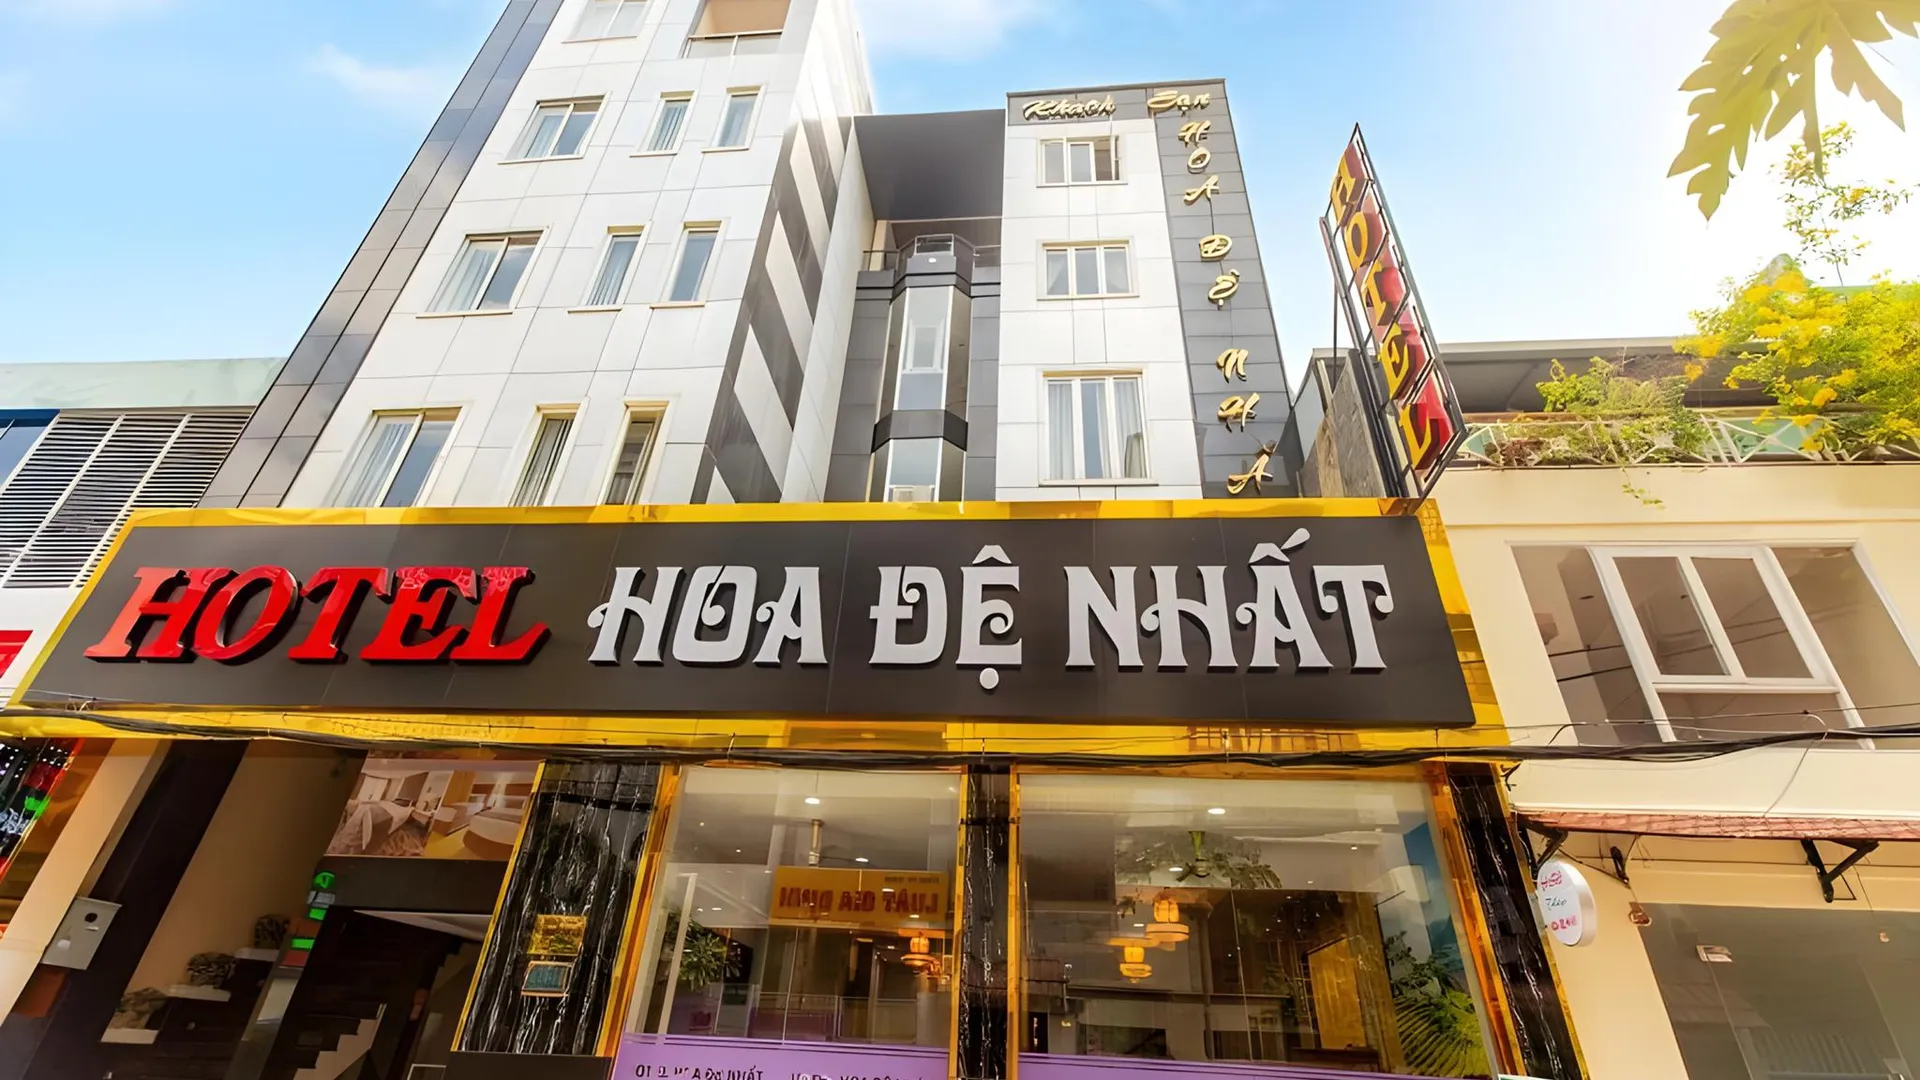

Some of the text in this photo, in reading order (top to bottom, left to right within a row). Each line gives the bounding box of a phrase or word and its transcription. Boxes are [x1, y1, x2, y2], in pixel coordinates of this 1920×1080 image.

[1331, 152, 1432, 470] HOTEL
[83, 527, 1395, 690] HOTEL HOA ĐỆ NHẤT
